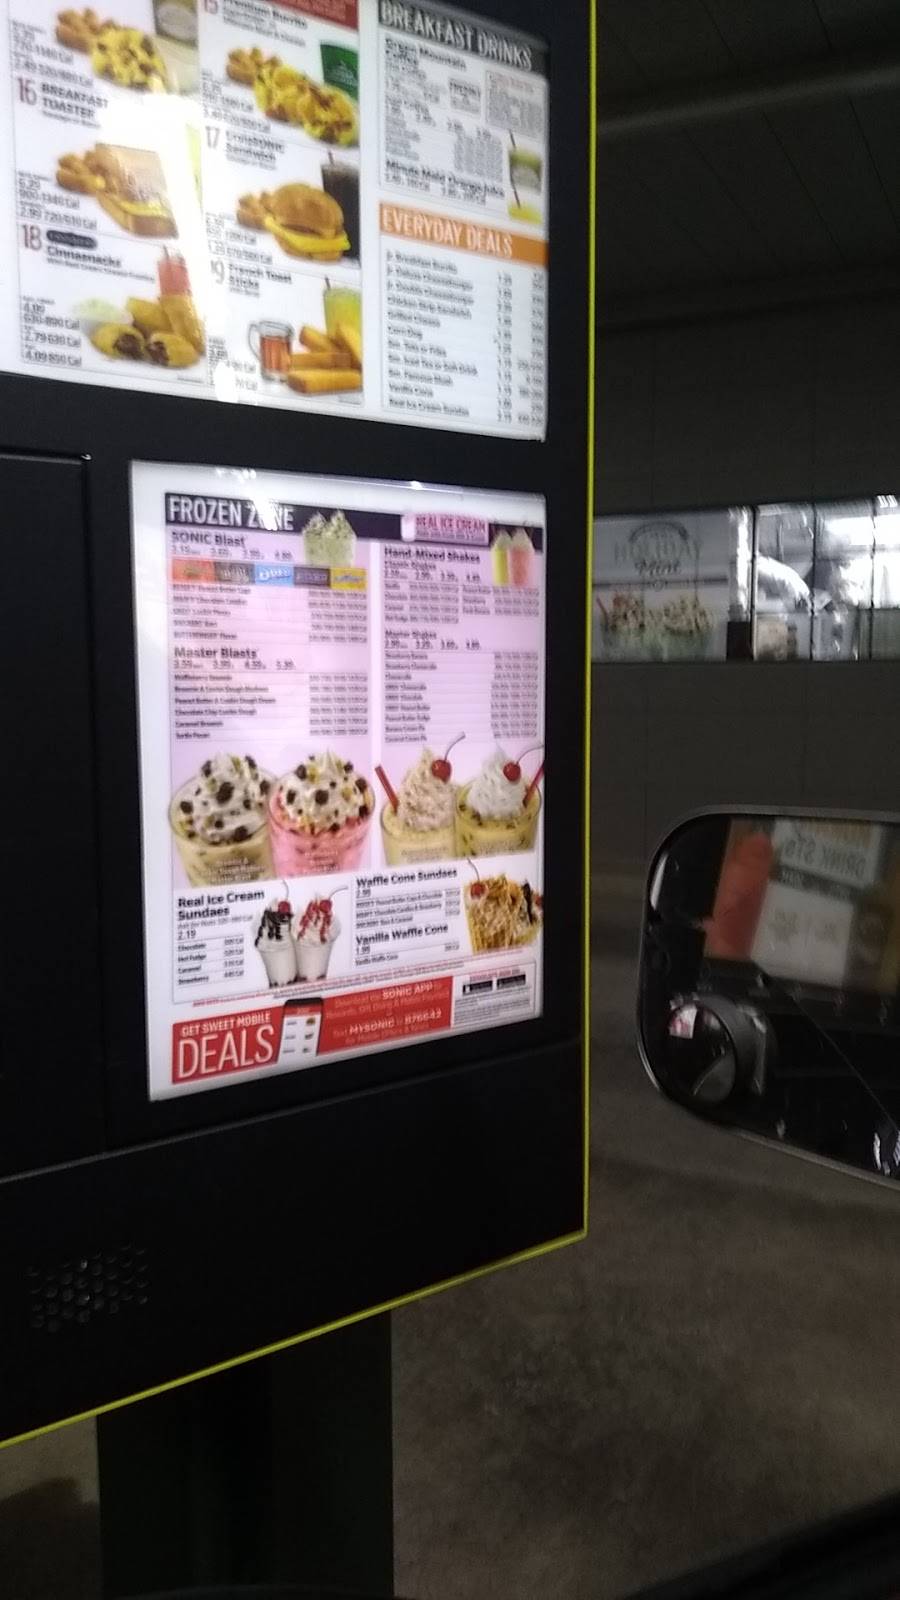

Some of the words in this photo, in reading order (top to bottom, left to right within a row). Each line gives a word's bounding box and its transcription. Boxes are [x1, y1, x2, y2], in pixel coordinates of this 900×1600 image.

[380, 0, 472, 51] BREAKFAST
[477, 31, 532, 71] DRINKS
[17, 77, 37, 106] 16
[41, 83, 108, 108] BREAKFAST
[42, 97, 95, 119] TOASTER
[206, 126, 220, 149] 17
[22, 223, 42, 250] 18
[382, 207, 462, 247] EVERYDAY
[466, 224, 513, 259] DEALS
[168, 496, 242, 526] FROZEN
[247, 502, 294, 531] ZNE
[416, 514, 438, 528] REAL
[440, 516, 453, 530] ICE
[456, 517, 486, 533] CREAM
[171, 532, 212, 545] SONIC
[214, 533, 246, 549] Blast
[448, 551, 480, 563] Shakes
[174, 645, 218, 659] Master
[220, 646, 258, 660] Blasts
[356, 873, 388, 887] Waffle
[390, 873, 416, 885] Cone
[417, 868, 457, 881] Sundaes
[178, 896, 205, 908] Real
[207, 894, 224, 905] Ice
[226, 889, 265, 903] Cream
[178, 906, 230, 921] Sundaes
[355, 931, 390, 946] Vanilla
[391, 926, 422, 938] Waffle
[425, 924, 448, 936] Cone
[382, 986, 412, 1000] SONIC
[414, 981, 433, 995] APP
[181, 1025, 200, 1037] GET
[202, 1018, 235, 1034] SWEET
[236, 1011, 272, 1028] MOBILE
[348, 1017, 395, 1035] MYSONIC
[178, 1024, 275, 1079] DEALS
